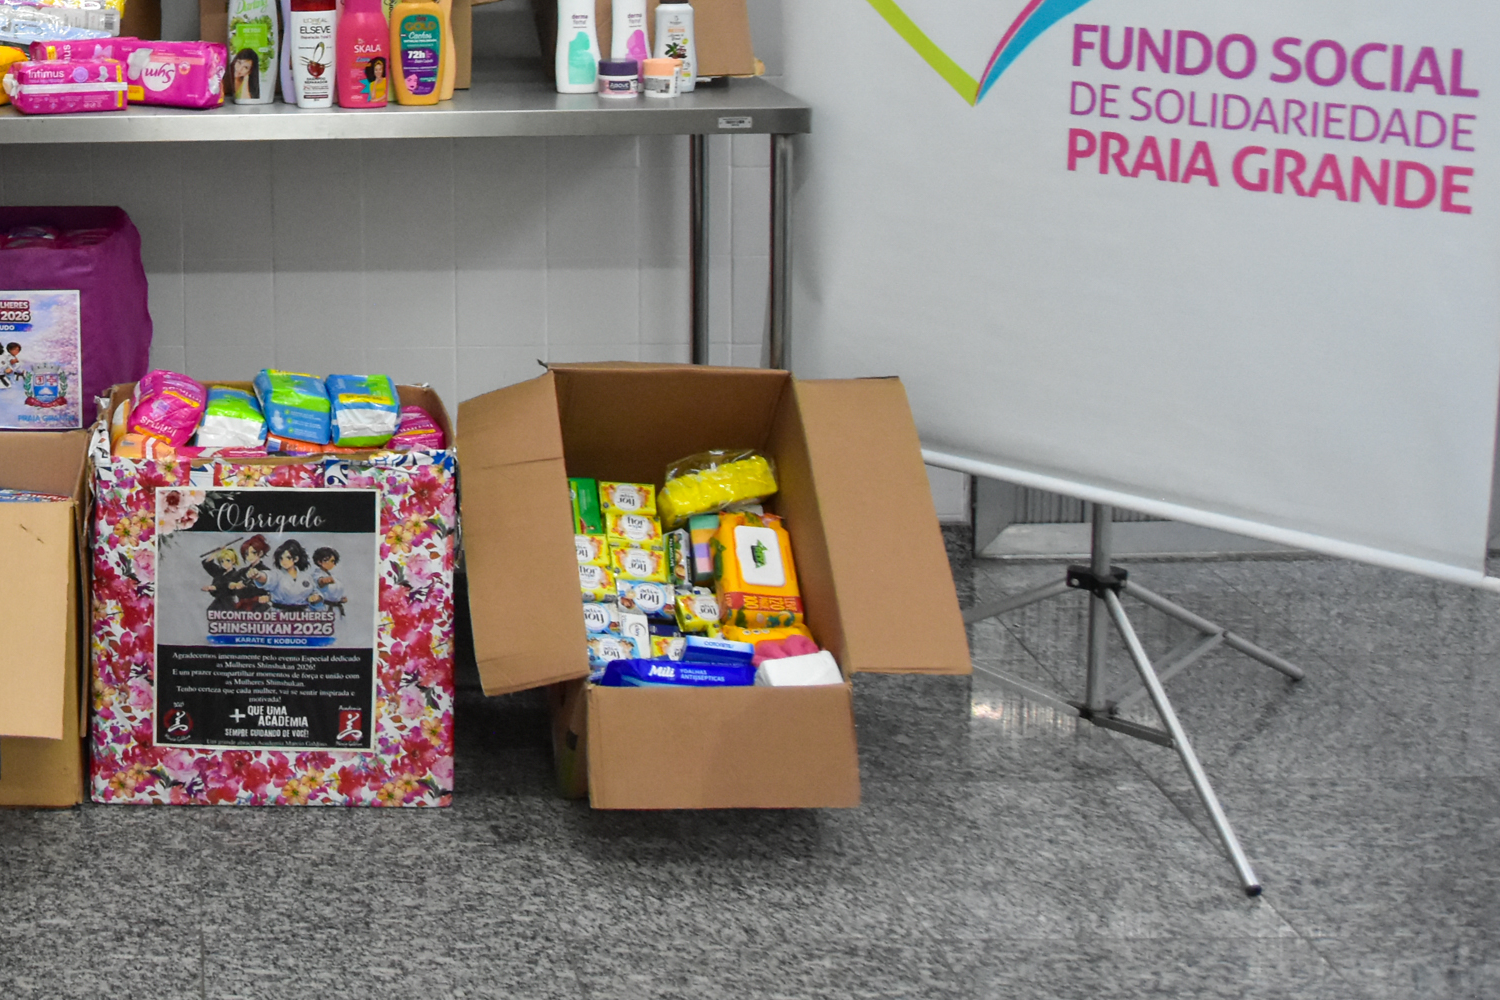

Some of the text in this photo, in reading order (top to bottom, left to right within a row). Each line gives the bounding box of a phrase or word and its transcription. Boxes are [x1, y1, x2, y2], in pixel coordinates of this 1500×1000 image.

[300, 26, 331, 35] ELSEVE
[405, 21, 437, 32] GOLD
[354, 44, 381, 54] SKALA
[407, 50, 426, 59] 72h
[1072, 23, 1480, 98] FUNDO SOCIAL
[28, 69, 65, 79] Intimus
[145, 63, 175, 84] Sym
[1069, 81, 1478, 152] DE SOLIDARIEDADE
[1067, 128, 1475, 215] PRAIA GRANDE
[1, 311, 30, 321] 2026
[17, 414, 40, 422] PRAIA
[216, 502, 326, 536] Obrigado
[208, 611, 334, 621] ENCONTRO DE MULHERES
[209, 622, 332, 634] SHINSHUKAN 2026
[172, 652, 217, 660] Agradecemos
[262, 654, 277, 662] pelo
[301, 655, 329, 663] Especial
[257, 662, 295, 670] Shinshukan
[649, 665, 675, 678] Mili
[213, 670, 255, 678] compartilhar
[301, 672, 319, 680] força
[247, 705, 287, 716] QUE UMA
[258, 715, 309, 727] ACADEMIA
[224, 728, 309, 738] SEMPRE CUIDANDO DE VOCÊ!
